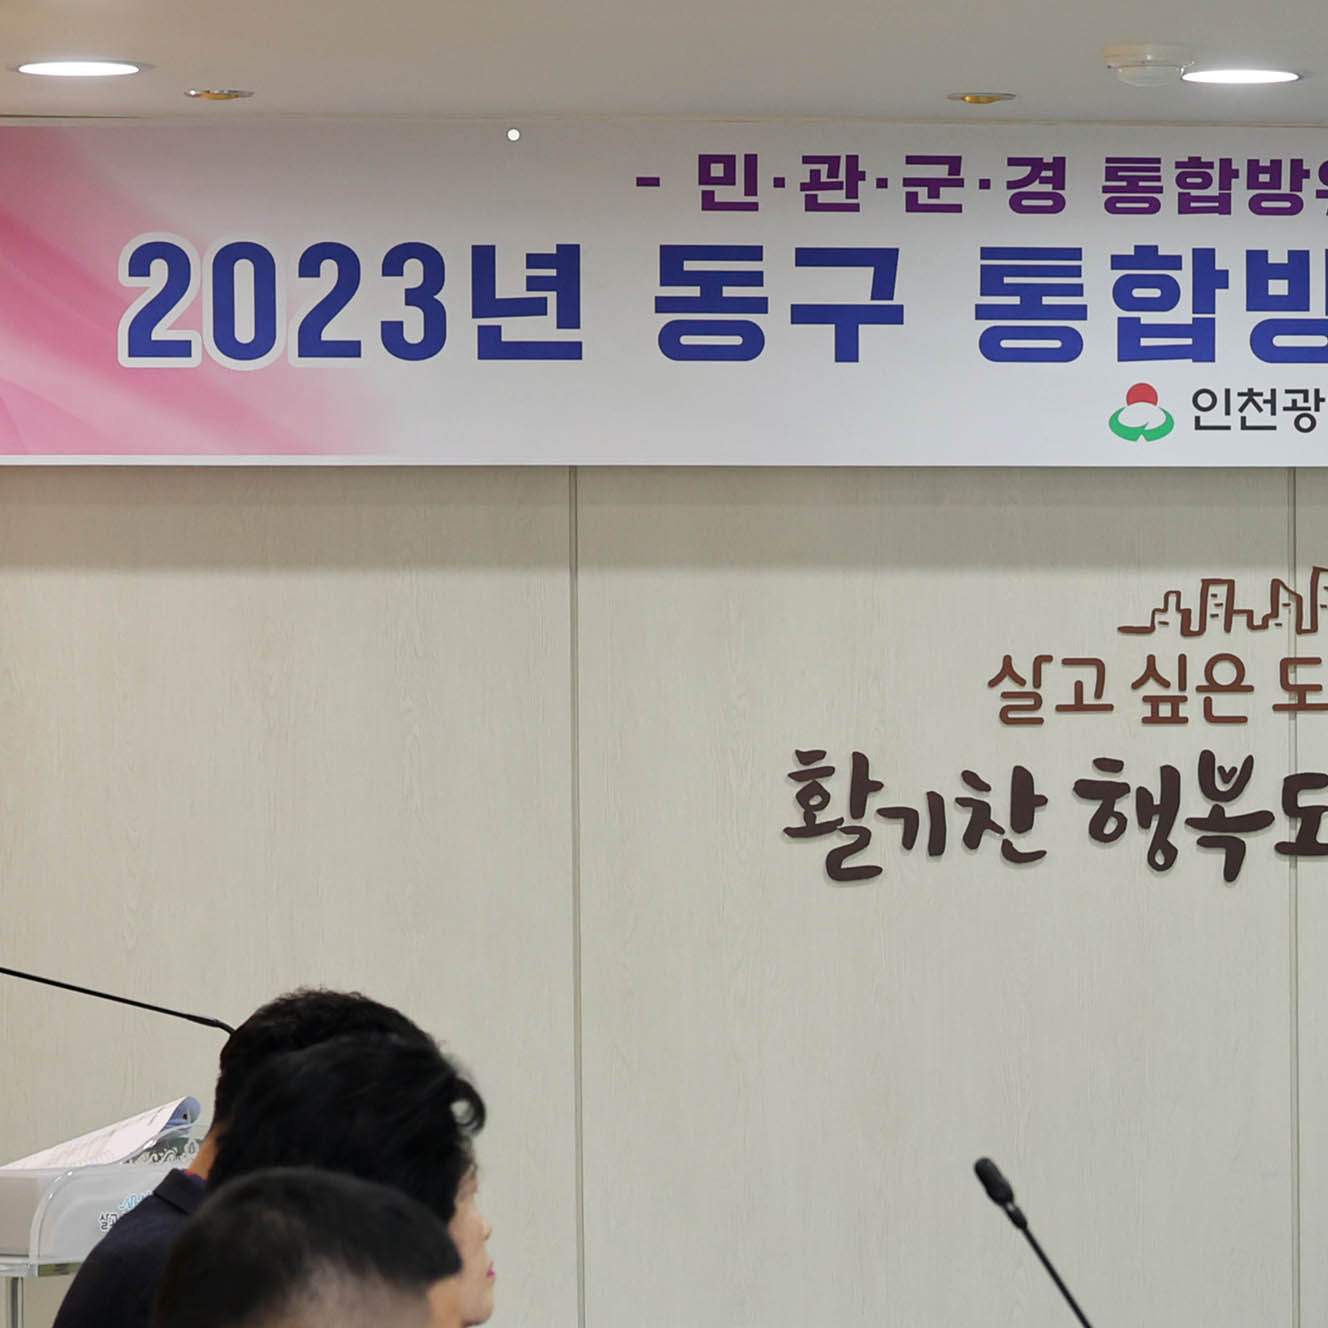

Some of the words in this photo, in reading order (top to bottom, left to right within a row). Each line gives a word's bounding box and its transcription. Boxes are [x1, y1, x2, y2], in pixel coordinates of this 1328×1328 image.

[698, 153, 1068, 216] 민·관·군·경
[128, 242, 584, 363] 2023년
[655, 245, 906, 364] 동구
[988, 654, 1115, 727] 살고
[1131, 654, 1256, 726] 싶은
[783, 749, 1049, 884] 활기찬
